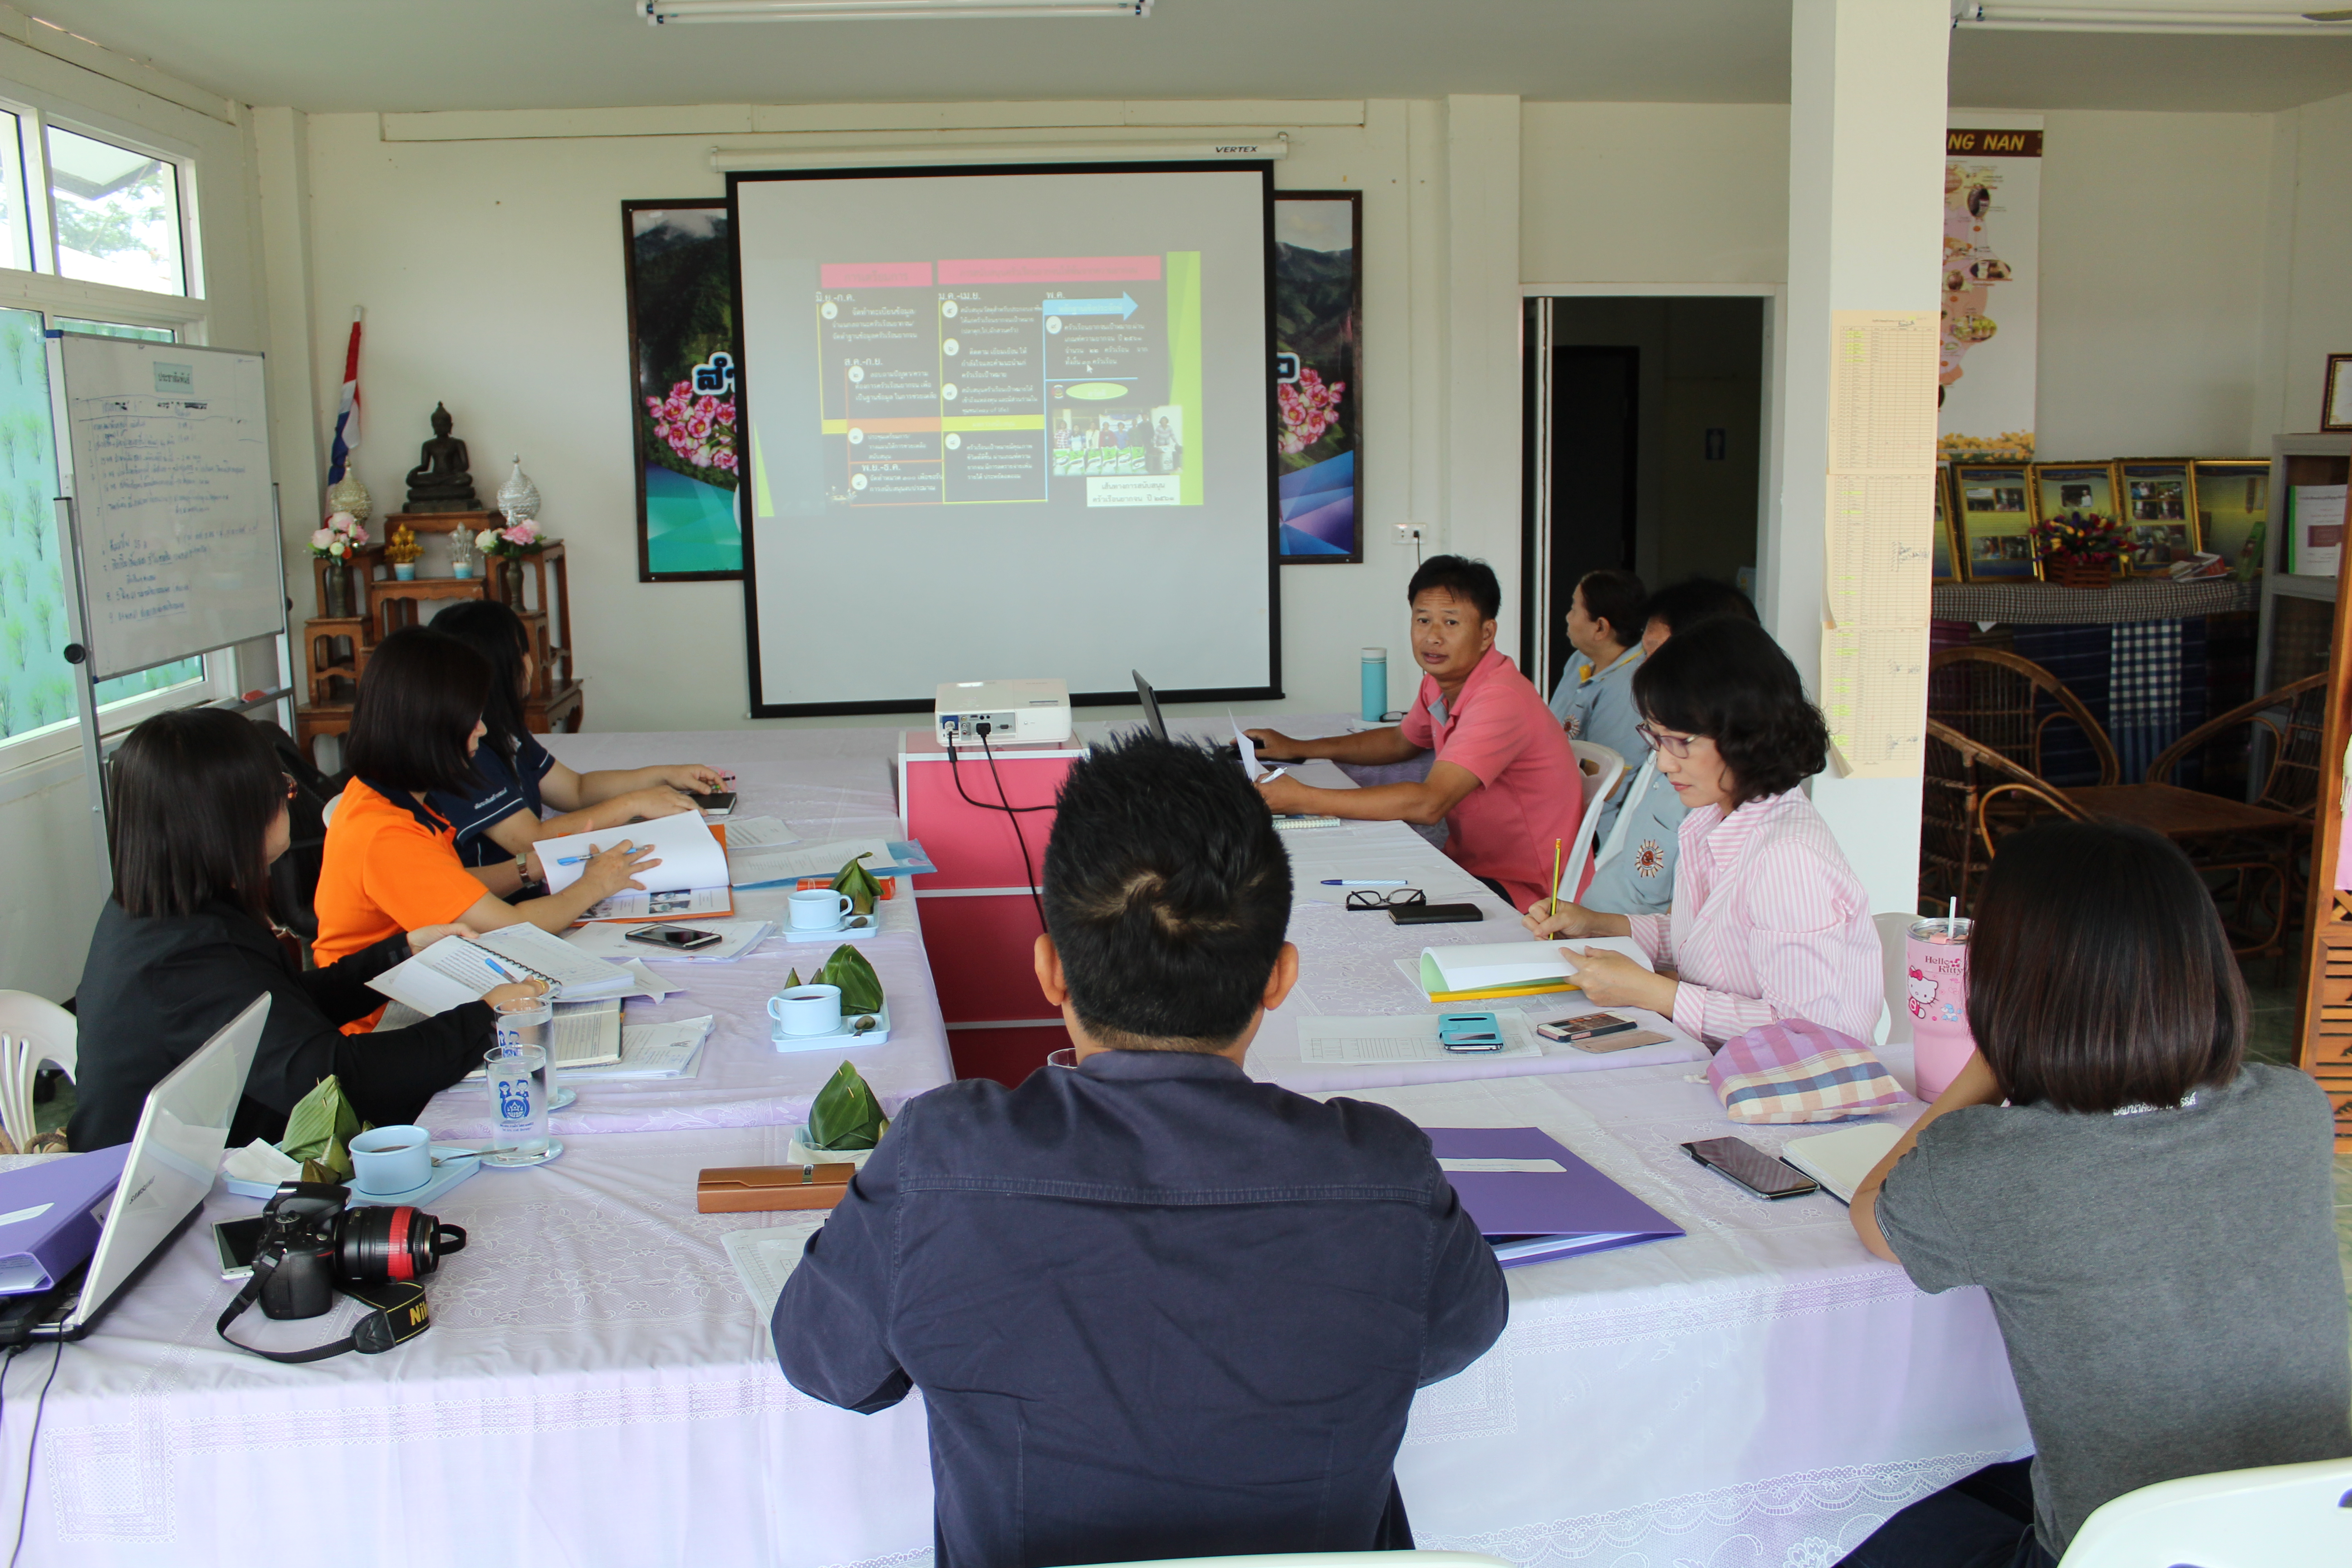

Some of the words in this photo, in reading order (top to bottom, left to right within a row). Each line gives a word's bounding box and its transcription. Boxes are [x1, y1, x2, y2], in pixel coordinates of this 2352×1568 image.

[1983, 134, 2025, 151] NAN
[938, 292, 981, 301] ม.ค.-เม.ย.
[1045, 291, 1066, 299] พ.ค.
[844, 358, 884, 366] ส.ค.-ก.ย.
[861, 463, 901, 471] พ.ย.-ธ.ค.
[1925, 955, 1950, 965] Hello
[1938, 965, 1964, 975] Kitty
